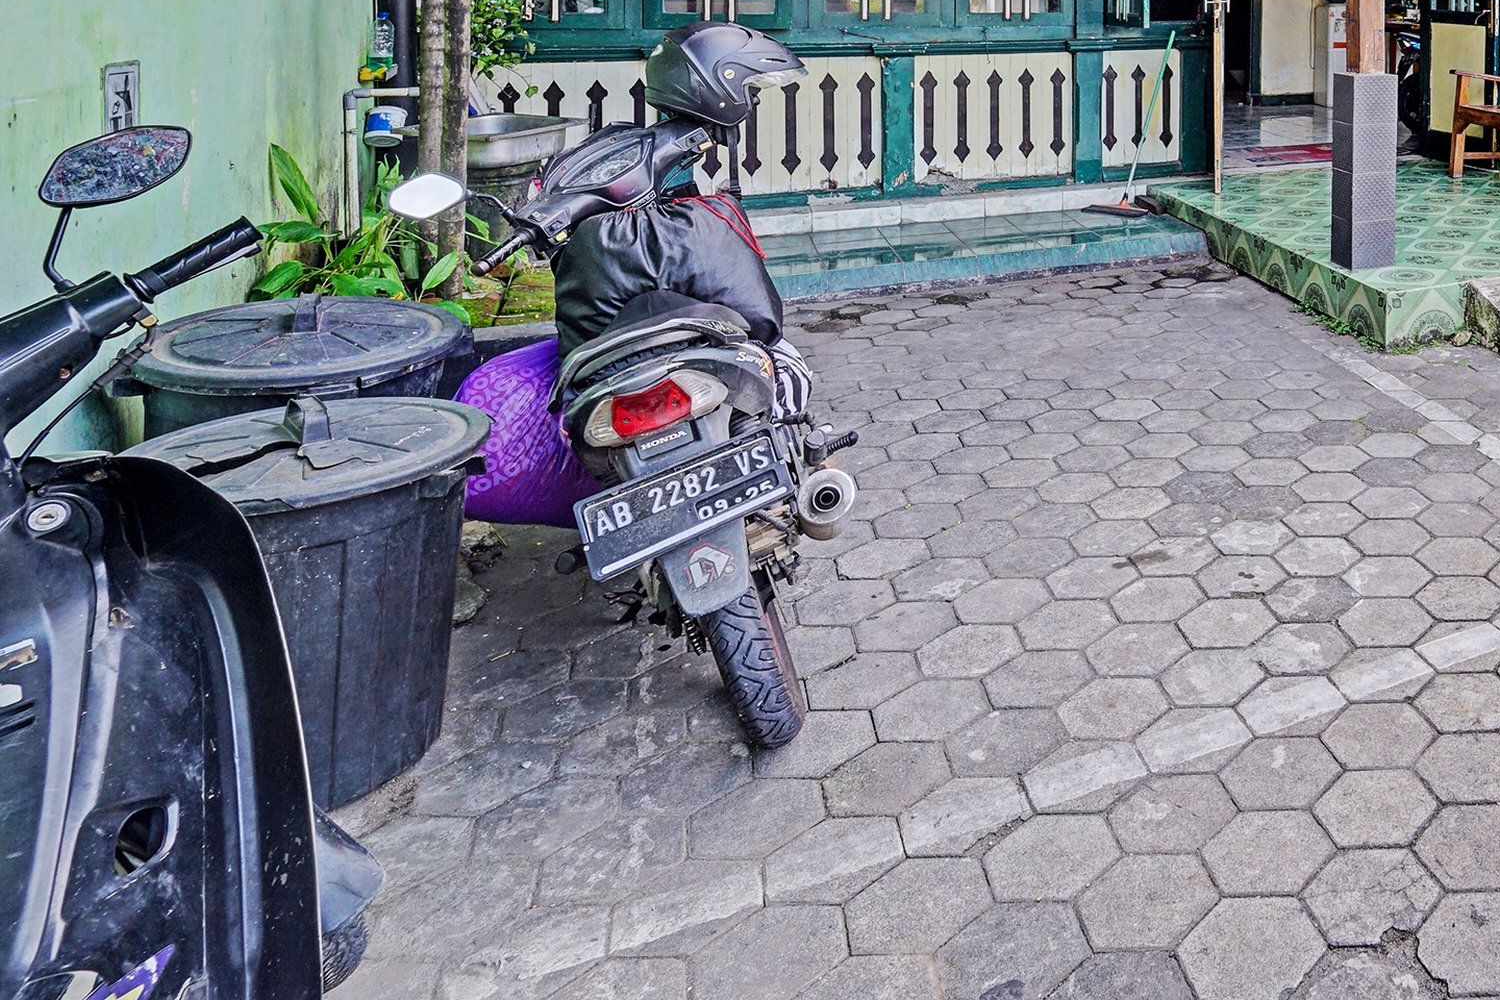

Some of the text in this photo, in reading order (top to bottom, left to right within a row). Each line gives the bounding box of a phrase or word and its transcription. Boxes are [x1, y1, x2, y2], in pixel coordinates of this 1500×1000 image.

[640, 430, 688, 451] HONDA
[597, 445, 771, 536] AB 2282 VS
